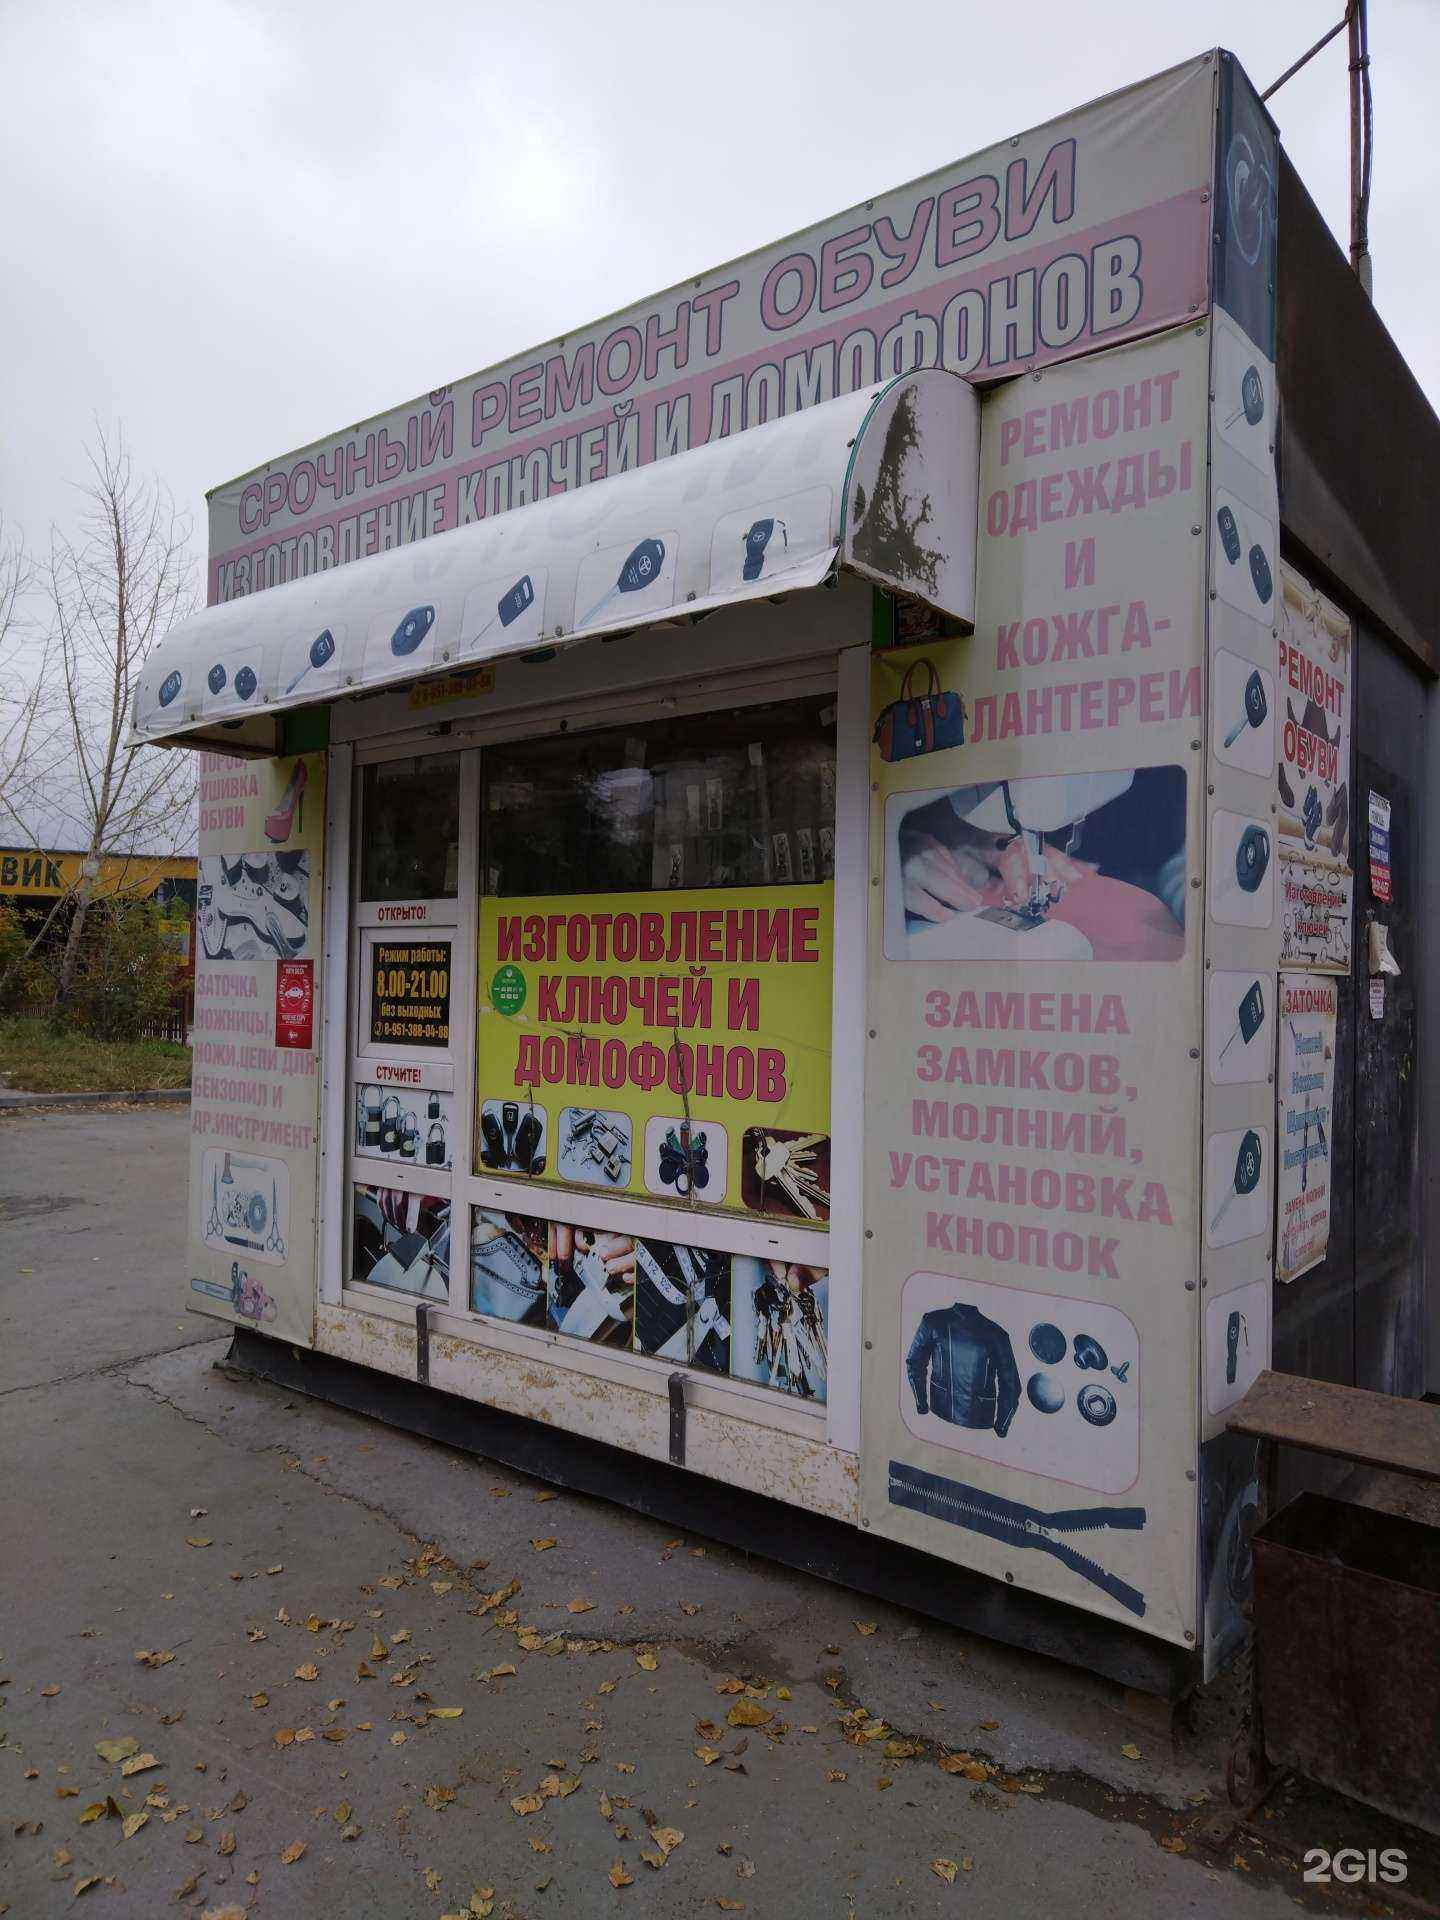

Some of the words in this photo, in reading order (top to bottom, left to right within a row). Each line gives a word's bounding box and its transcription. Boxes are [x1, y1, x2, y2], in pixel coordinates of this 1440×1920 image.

[239, 386, 454, 534] СРОЧНЫЙ
[472, 280, 740, 448] РЕМОНТ
[761, 138, 1077, 332] ОБУВИ
[1000, 369, 1180, 467] РЕМОНТ
[217, 484, 446, 605] ИЗГОТОВЛЕНИЕ
[457, 399, 640, 527] КЛЮЧЕЙ
[655, 393, 691, 462] И
[986, 441, 1192, 538] ОДЕЖДЫ
[1064, 537, 1096, 590] И
[996, 600, 1171, 671] КОЖГА-
[970, 665, 1201, 743] ЛАНТЕРЕИ
[1279, 639, 1345, 718] РЕМОНТ
[1283, 719, 1339, 785] ОБУВИ
[199, 774, 258, 803] УШИВКА
[200, 805, 245, 832] ОБУВИ
[378, 906, 426, 921] ОТКРЫТО!
[496, 907, 819, 963] ИЗГОТОВЛЕНИЕ
[377, 969, 448, 999] 8.00-21.00
[379, 947, 410, 963] Режим
[411, 948, 446, 964] работы:
[196, 973, 257, 998] ЗАТОЧКА
[381, 1002, 396, 1018] без
[397, 1005, 441, 1020] выходных
[537, 965, 712, 1029] КЛЮЧЕЙ
[727, 977, 760, 1032] И
[924, 989, 1131, 1035] ЗАМЕНА
[282, 1051, 316, 1077] ДЛЯ
[376, 1066, 422, 1083] СТУЧИТЕ!
[514, 1035, 787, 1103] ДОМОФОНОВ
[916, 1044, 1138, 1101] ЗАМКОВ,
[192, 1077, 269, 1108] БЕНЗОПИЛ
[272, 1084, 284, 1109] И
[911, 1098, 1144, 1165] МОЛНИЙ,
[888, 1150, 1174, 1226] УСТАНОВКА
[926, 1211, 1121, 1280] КНОПОК
